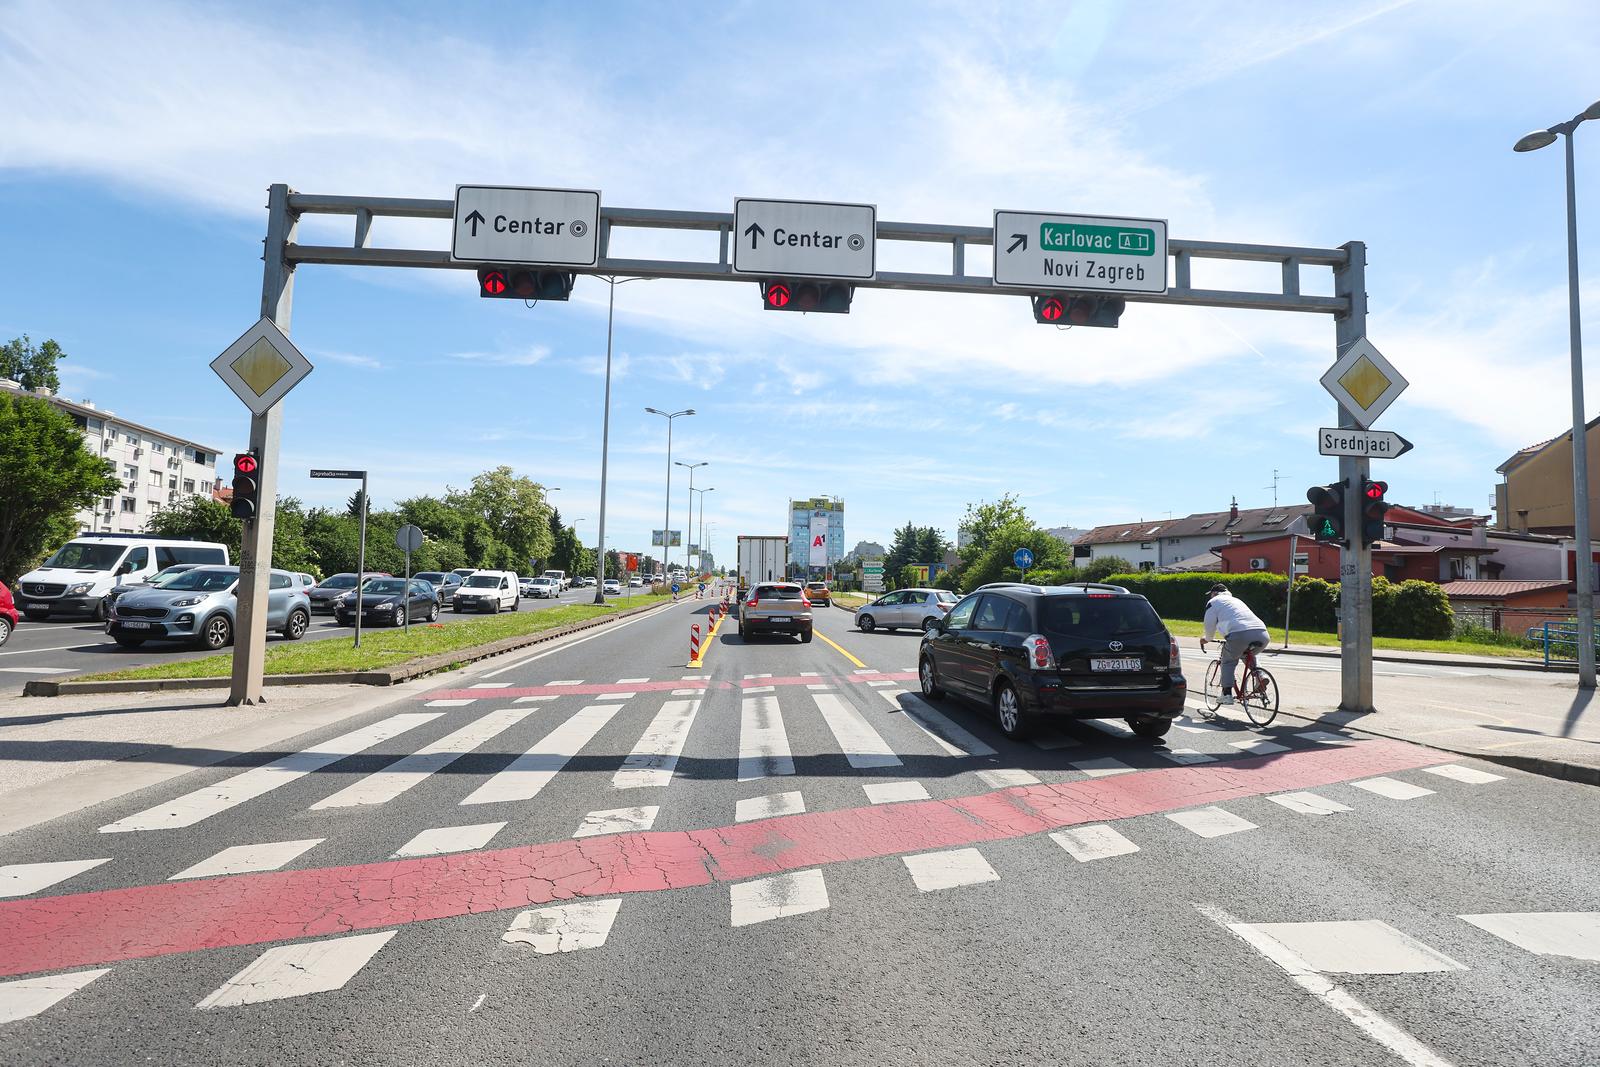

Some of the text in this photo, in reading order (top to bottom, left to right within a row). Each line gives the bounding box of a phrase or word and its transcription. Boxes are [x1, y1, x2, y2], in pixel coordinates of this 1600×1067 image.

[494, 215, 565, 235] Centar
[773, 228, 842, 248] Centar
[1044, 227, 1112, 249] Karlovac
[1044, 258, 1145, 284] Novi Zagreb
[1325, 434, 1390, 454] Srednjaci
